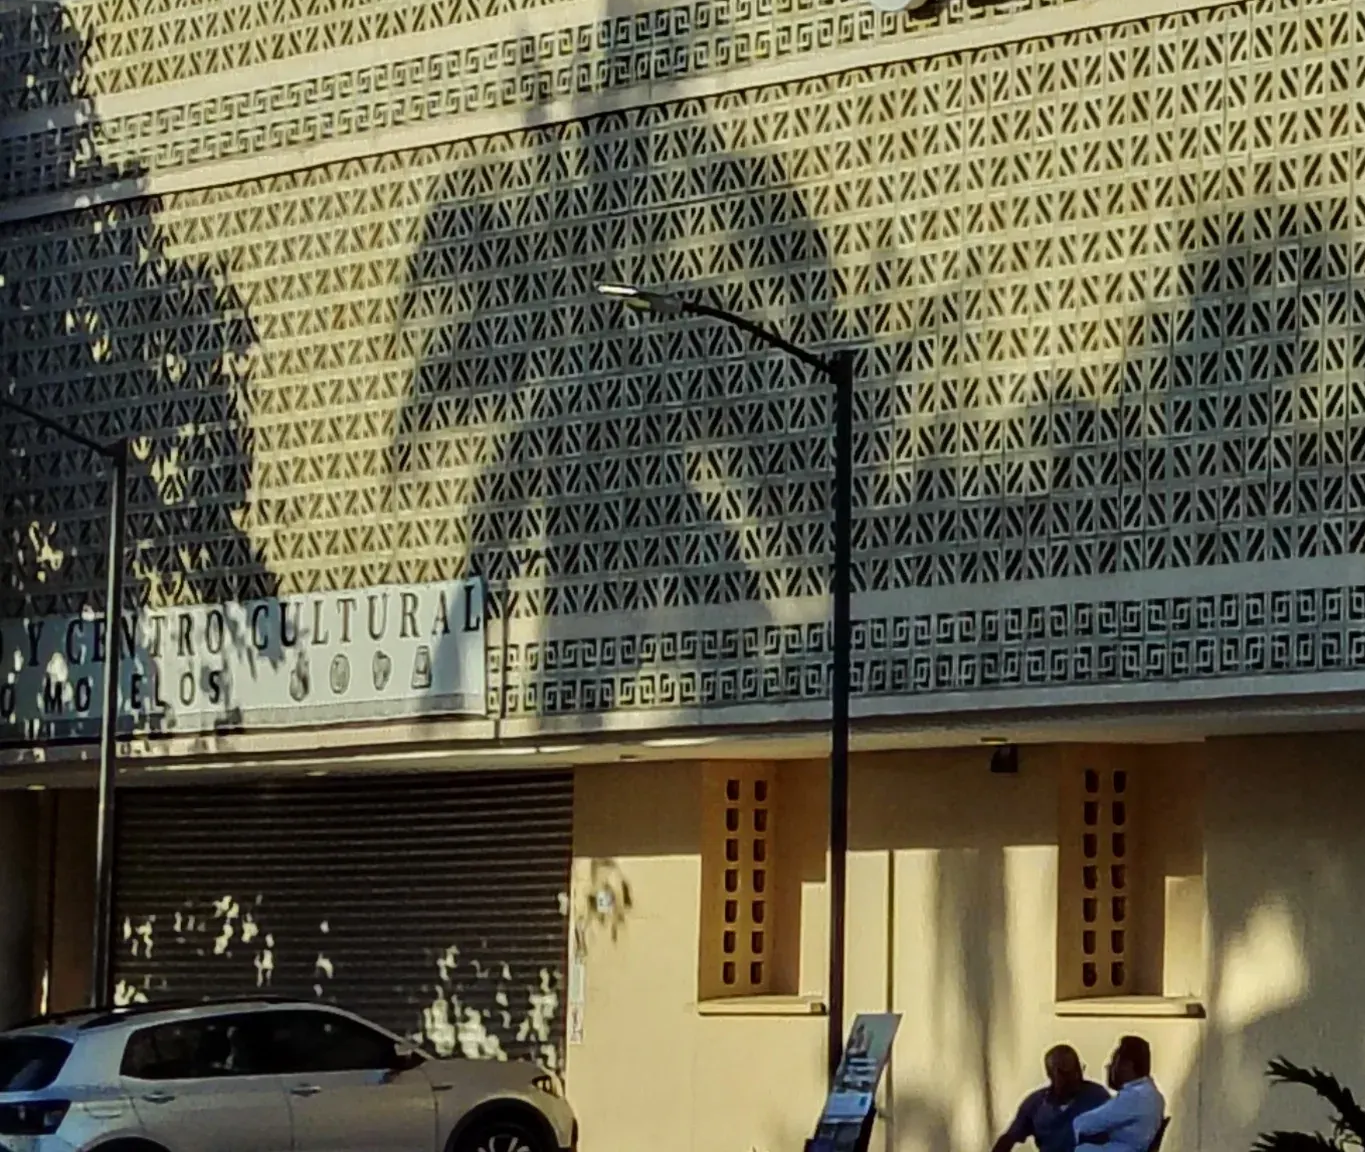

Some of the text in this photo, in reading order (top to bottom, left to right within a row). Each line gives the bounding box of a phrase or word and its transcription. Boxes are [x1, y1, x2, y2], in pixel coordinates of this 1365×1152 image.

[28, 622, 44, 666] Y
[252, 584, 481, 649] CULTURAL
[44, 670, 221, 714] MOELOS
